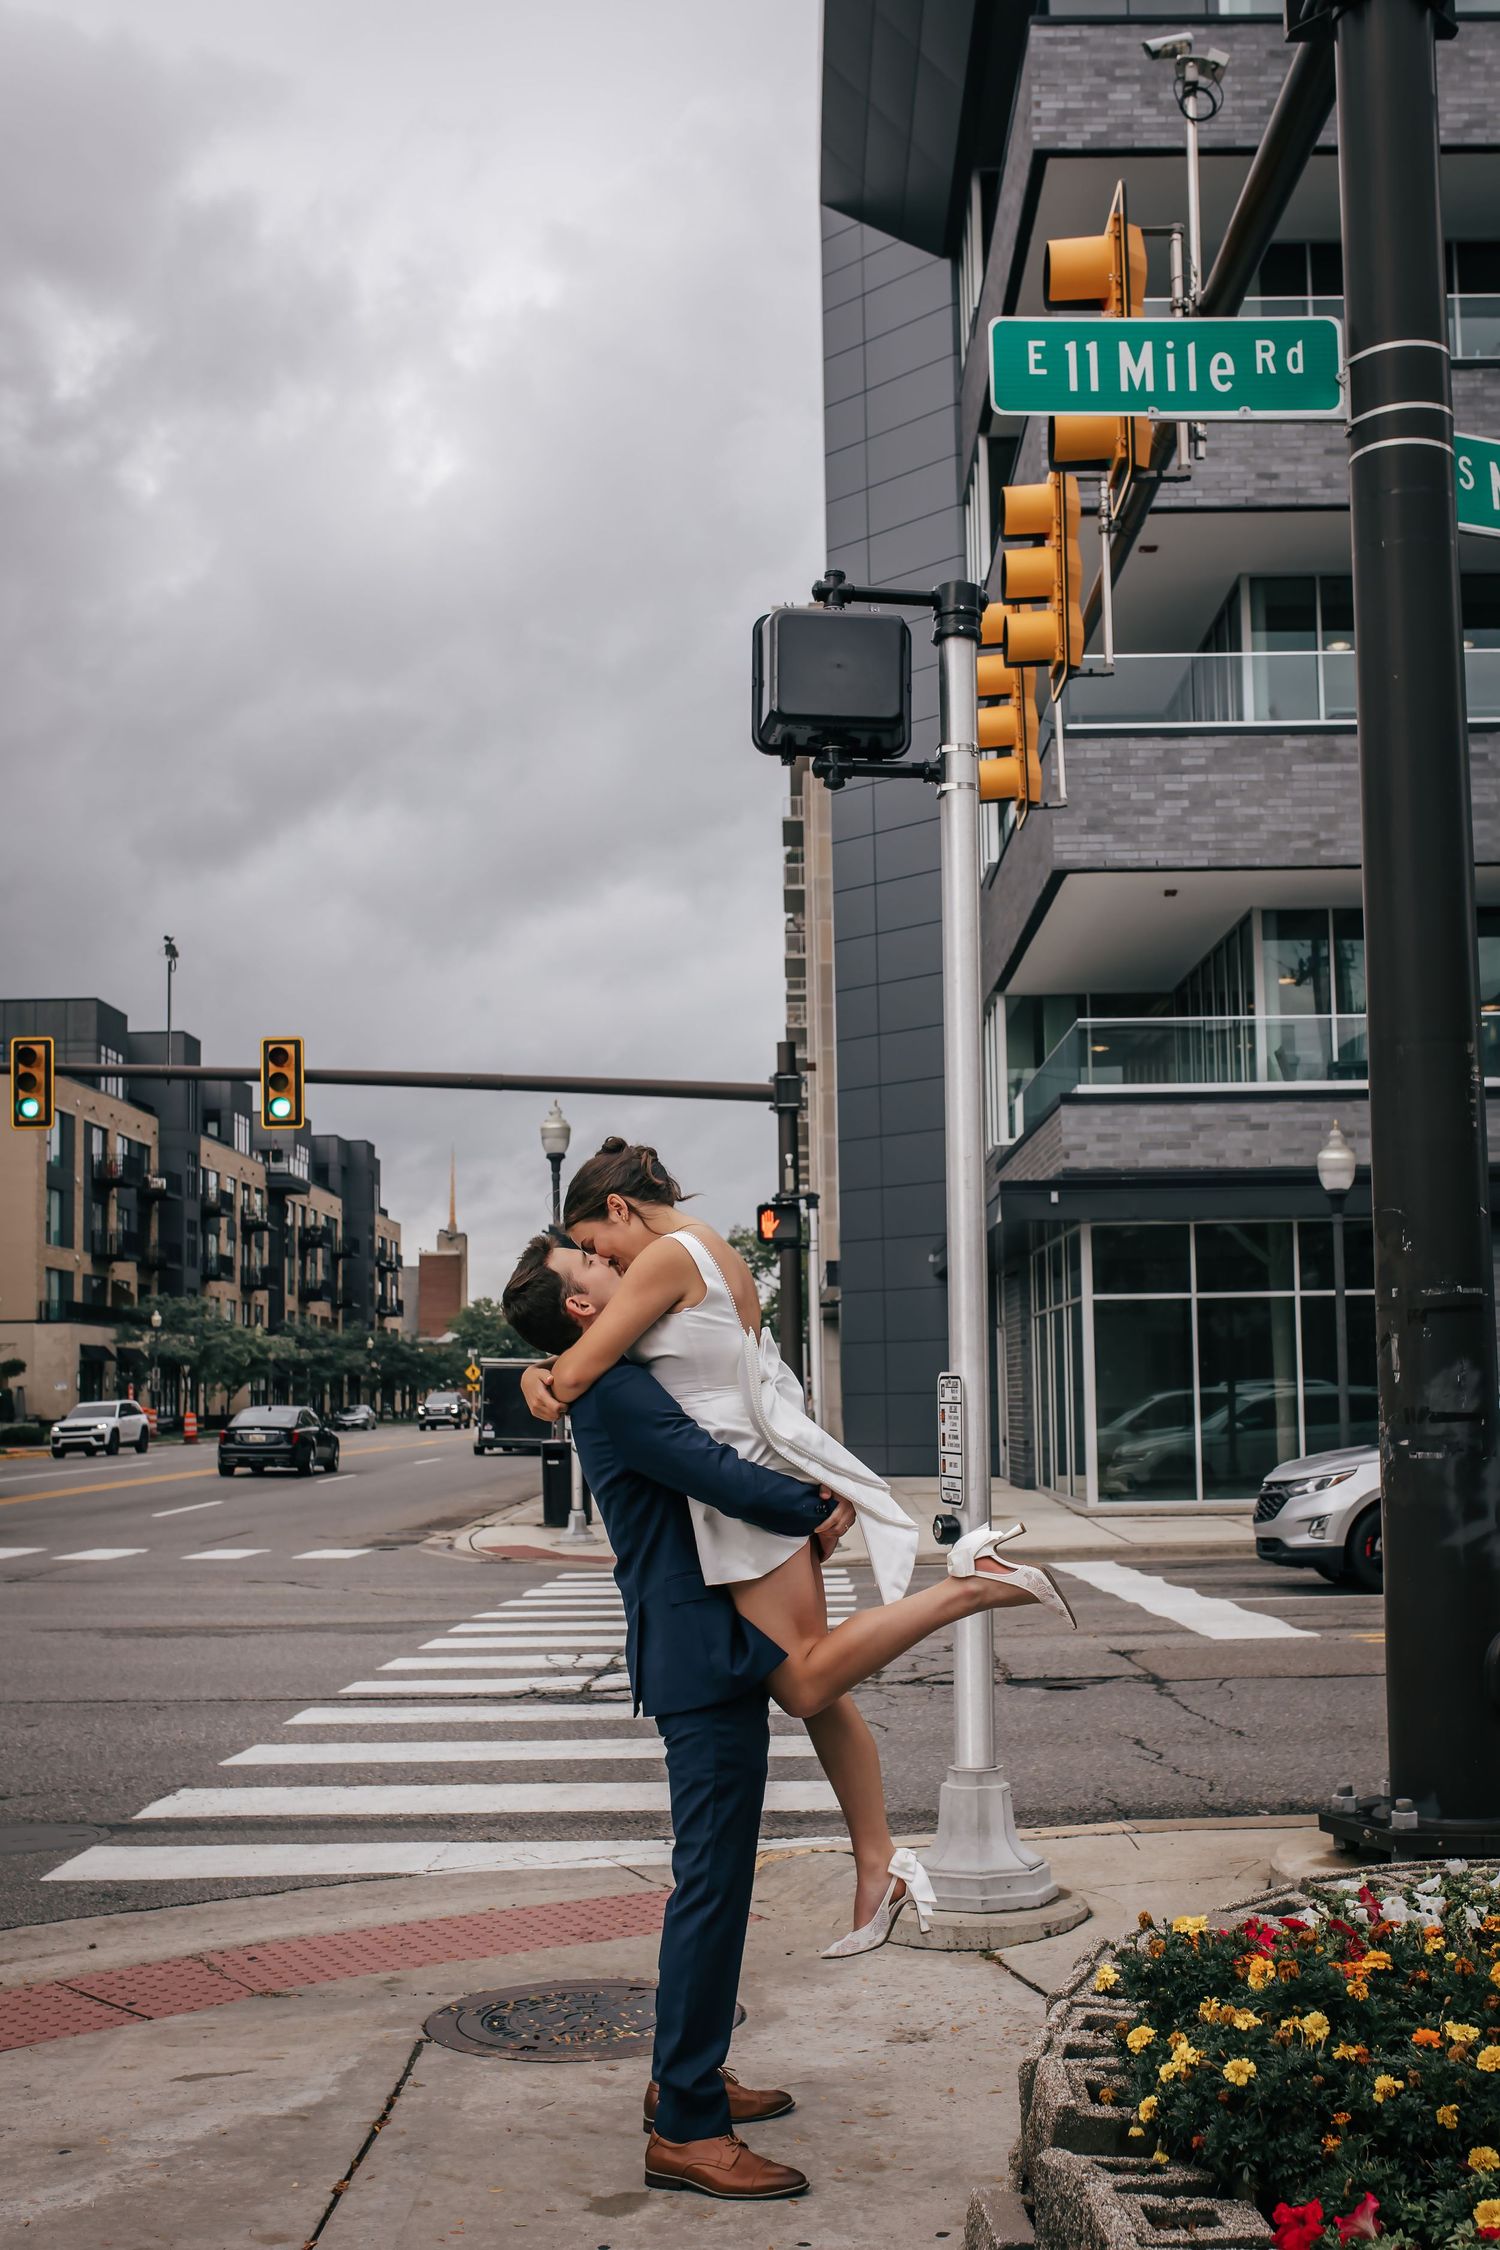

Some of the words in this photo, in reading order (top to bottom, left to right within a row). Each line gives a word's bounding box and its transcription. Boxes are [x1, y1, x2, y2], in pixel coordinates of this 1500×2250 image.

[1027, 340, 1048, 375] E
[1064, 341, 1099, 392] 11
[1118, 341, 1236, 392] Mile
[1255, 339, 1305, 375] Rd
[1458, 455, 1475, 490] S
